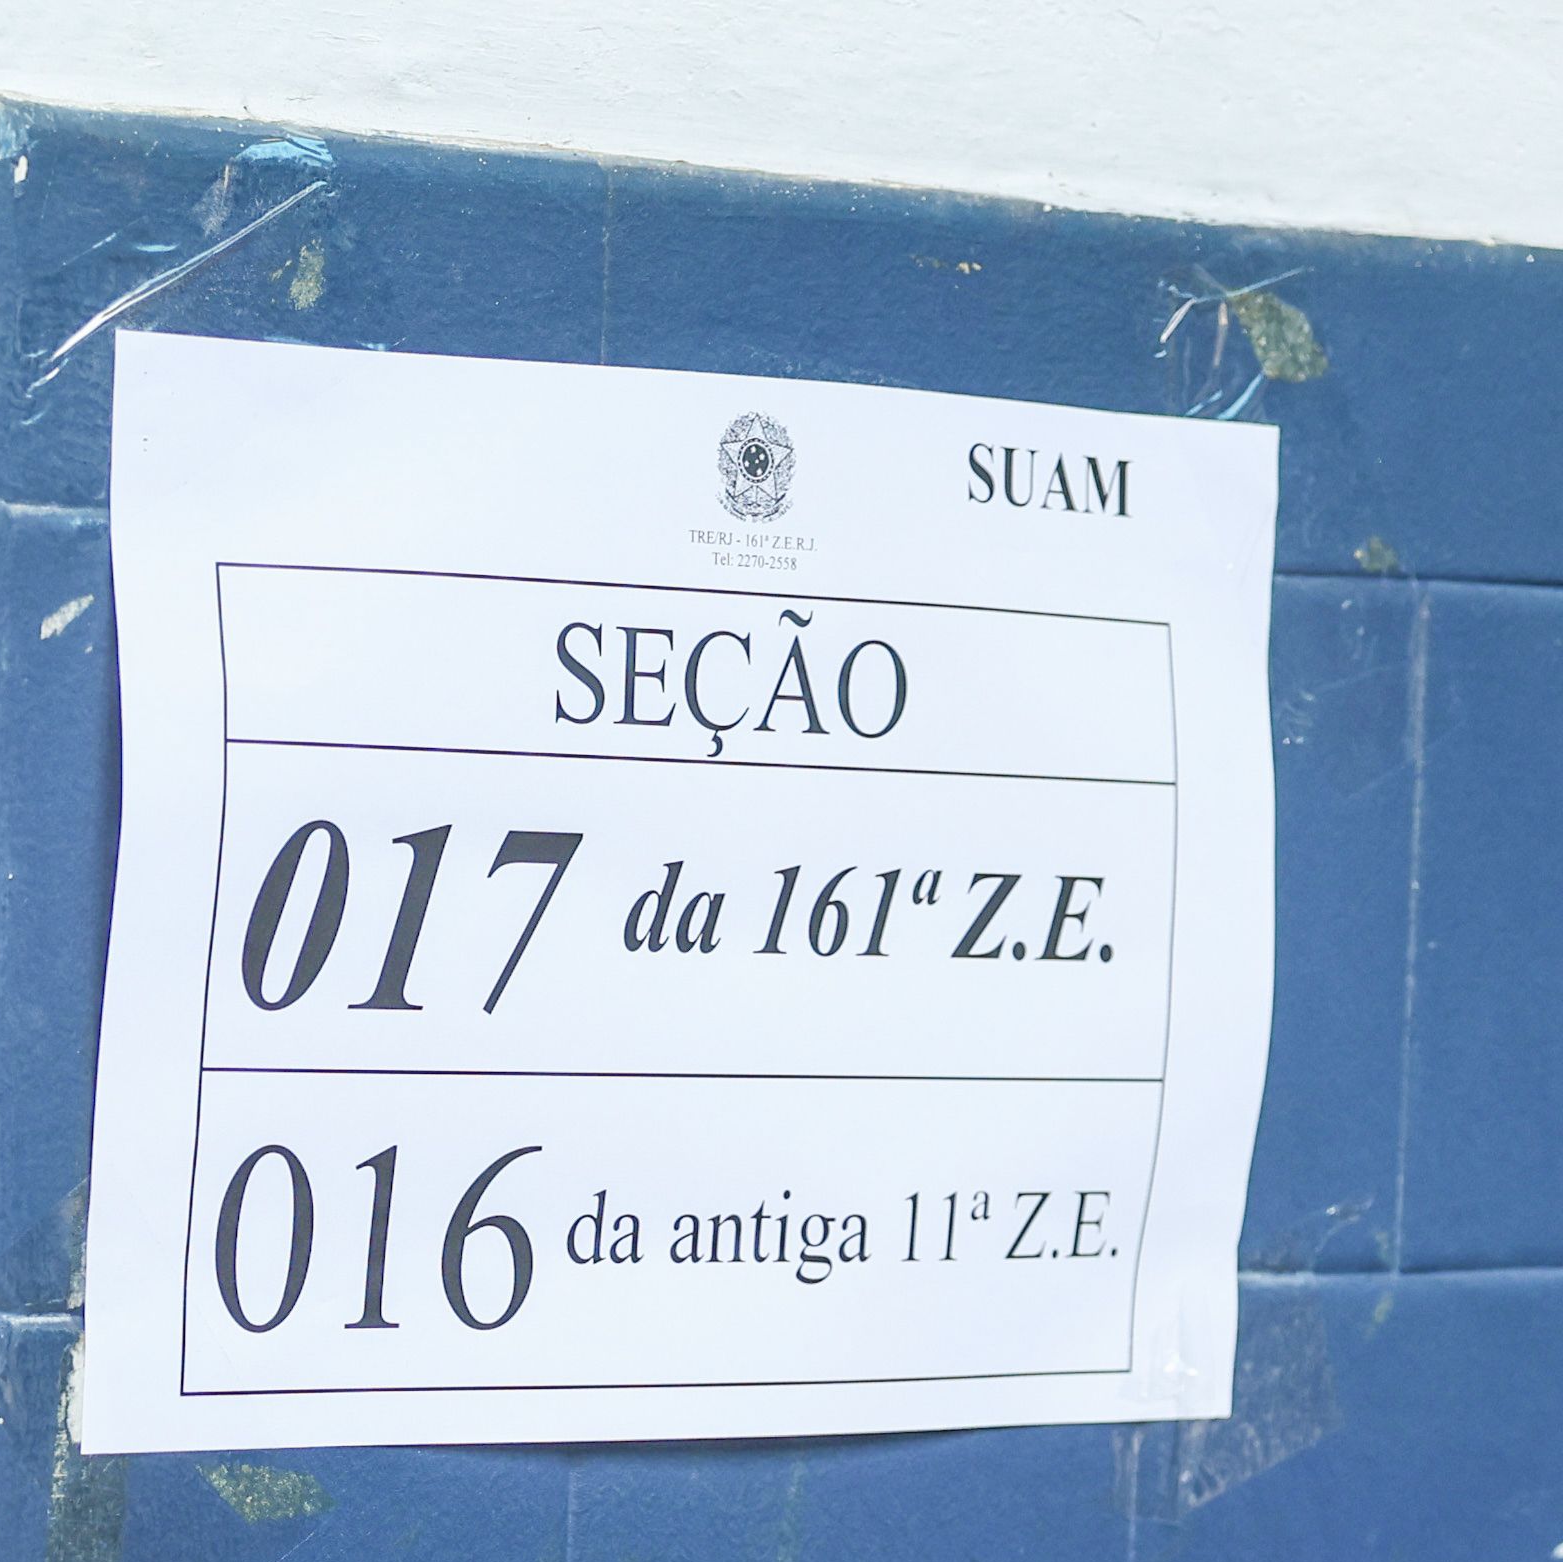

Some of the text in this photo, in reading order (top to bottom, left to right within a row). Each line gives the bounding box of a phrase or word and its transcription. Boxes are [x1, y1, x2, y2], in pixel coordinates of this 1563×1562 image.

[967, 443, 1132, 517] SUAM
[555, 609, 909, 757] SEÇÃO
[242, 820, 583, 1014] 017
[624, 861, 725, 953] da
[951, 873, 1112, 962] Z.E.
[216, 1145, 542, 1333] 016
[567, 1190, 642, 1264] da
[670, 1190, 868, 1284] antiga
[1005, 1192, 1117, 1259] Z.E.
